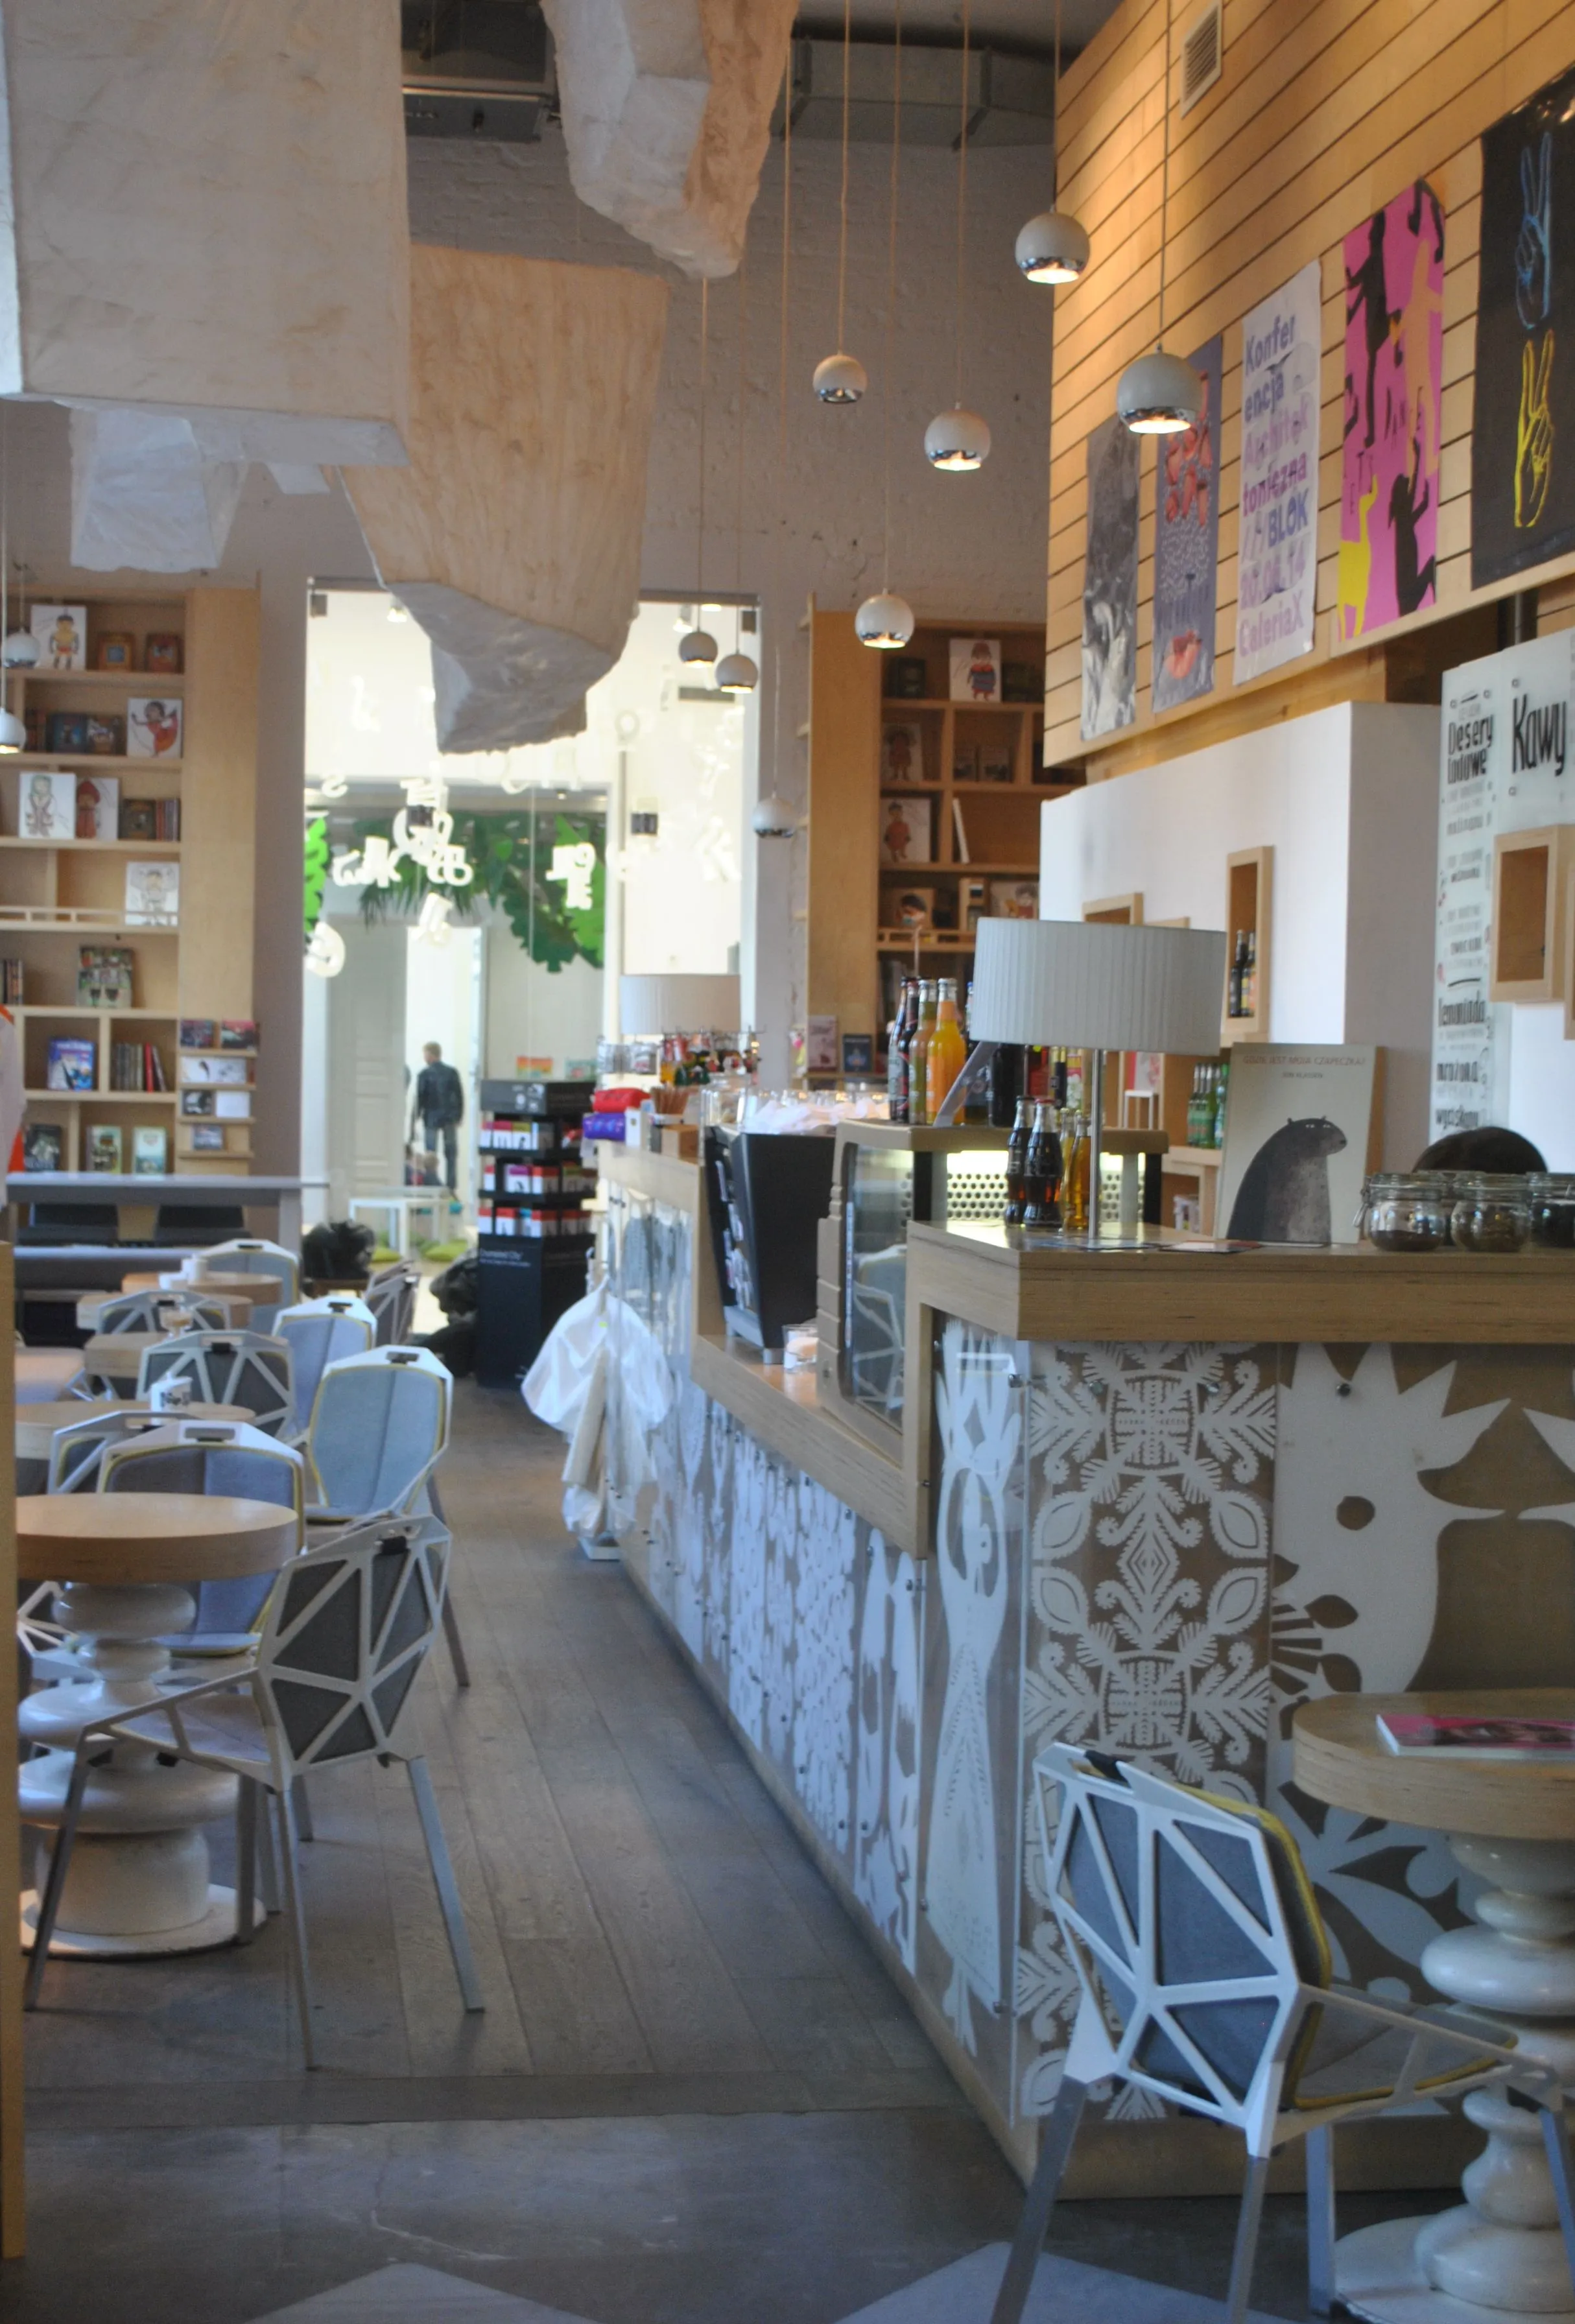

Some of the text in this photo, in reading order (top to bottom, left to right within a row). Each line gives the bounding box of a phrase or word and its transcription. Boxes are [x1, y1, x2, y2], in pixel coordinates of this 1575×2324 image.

[1246, 314, 1296, 377] Konfer
[1244, 372, 1285, 423] encja
[1242, 451, 1307, 517] toniczna
[1268, 488, 1309, 547] BLOK
[1448, 713, 1495, 757] Desery
[1512, 693, 1566, 777] Kawy
[1447, 748, 1487, 785] lodowe
